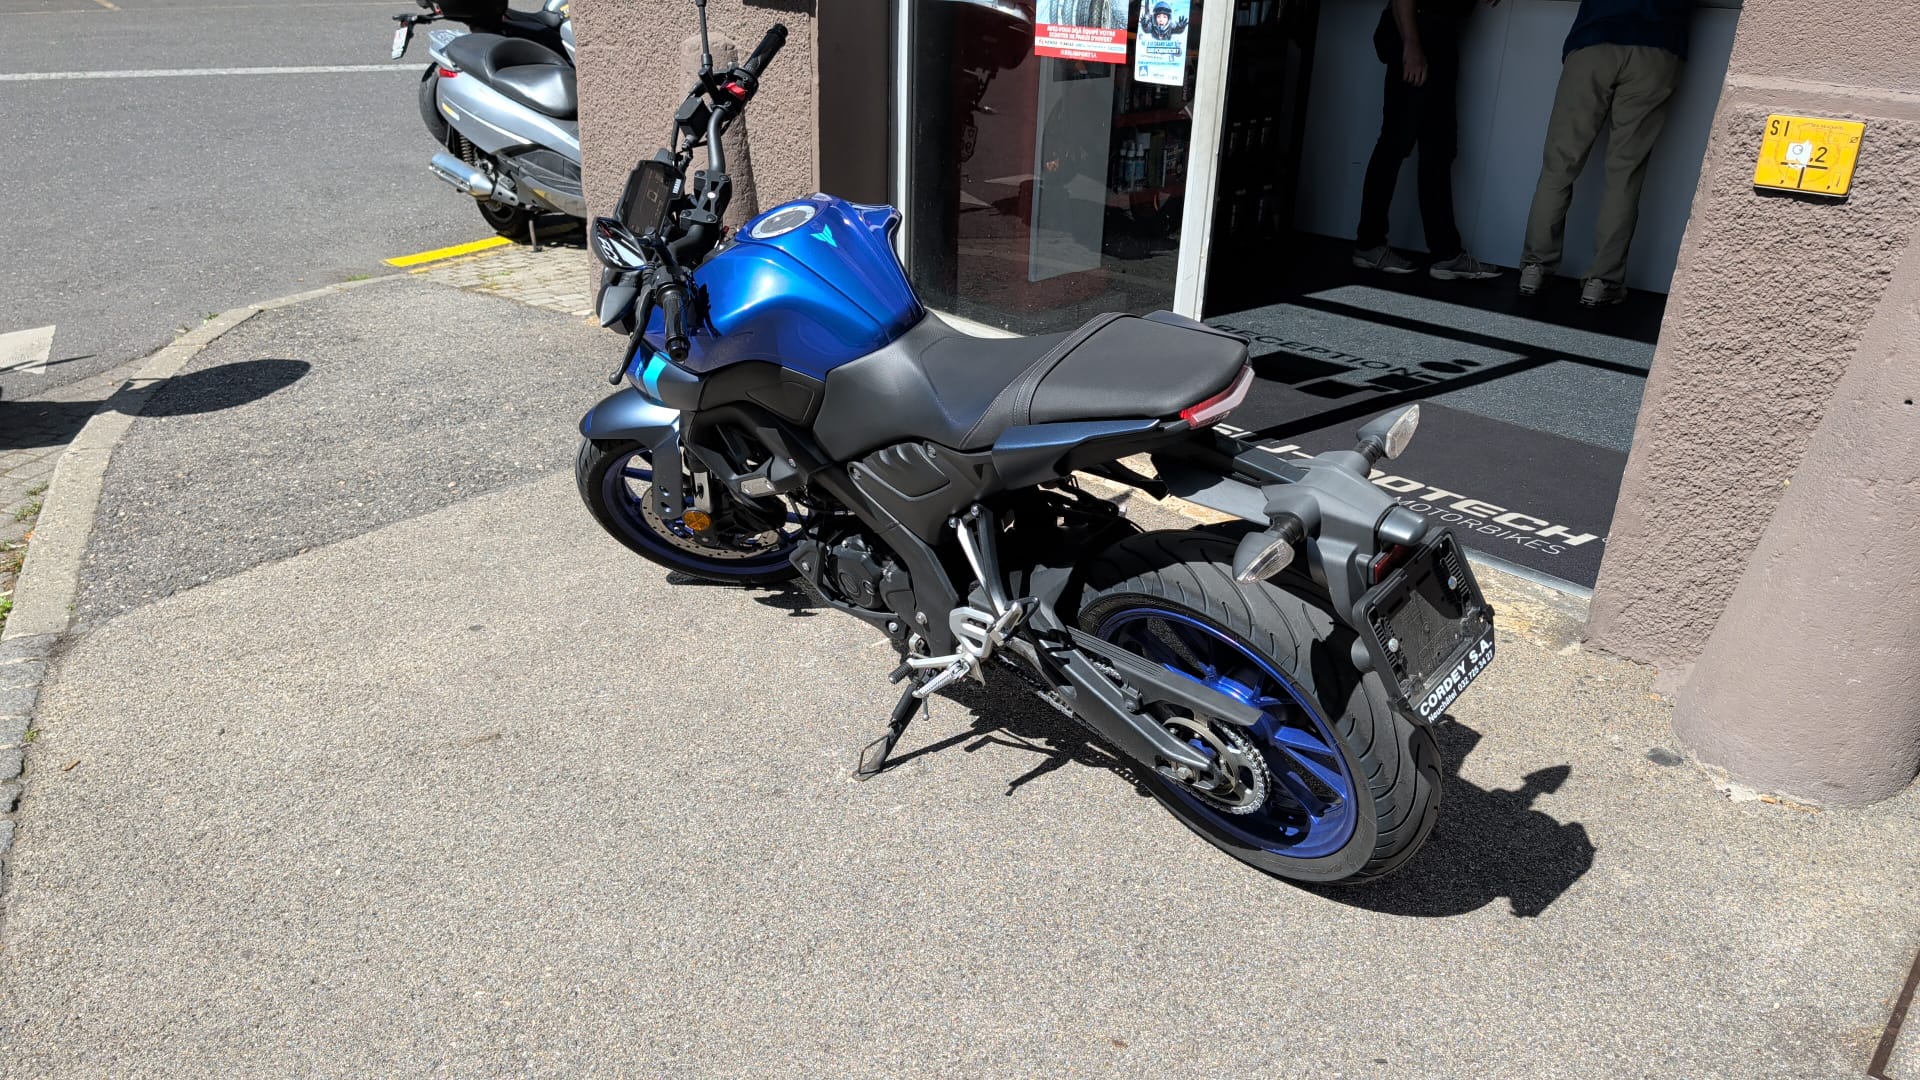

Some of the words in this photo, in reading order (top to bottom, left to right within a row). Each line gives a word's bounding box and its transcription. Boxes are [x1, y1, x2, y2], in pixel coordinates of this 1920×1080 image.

[1396, 495, 1567, 556] MOTORBIKES
[1420, 660, 1466, 716] CORDEY
[1469, 639, 1493, 664] S.A.
[1428, 688, 1458, 724] Neuchâtel
[1457, 677, 1470, 692] 032
